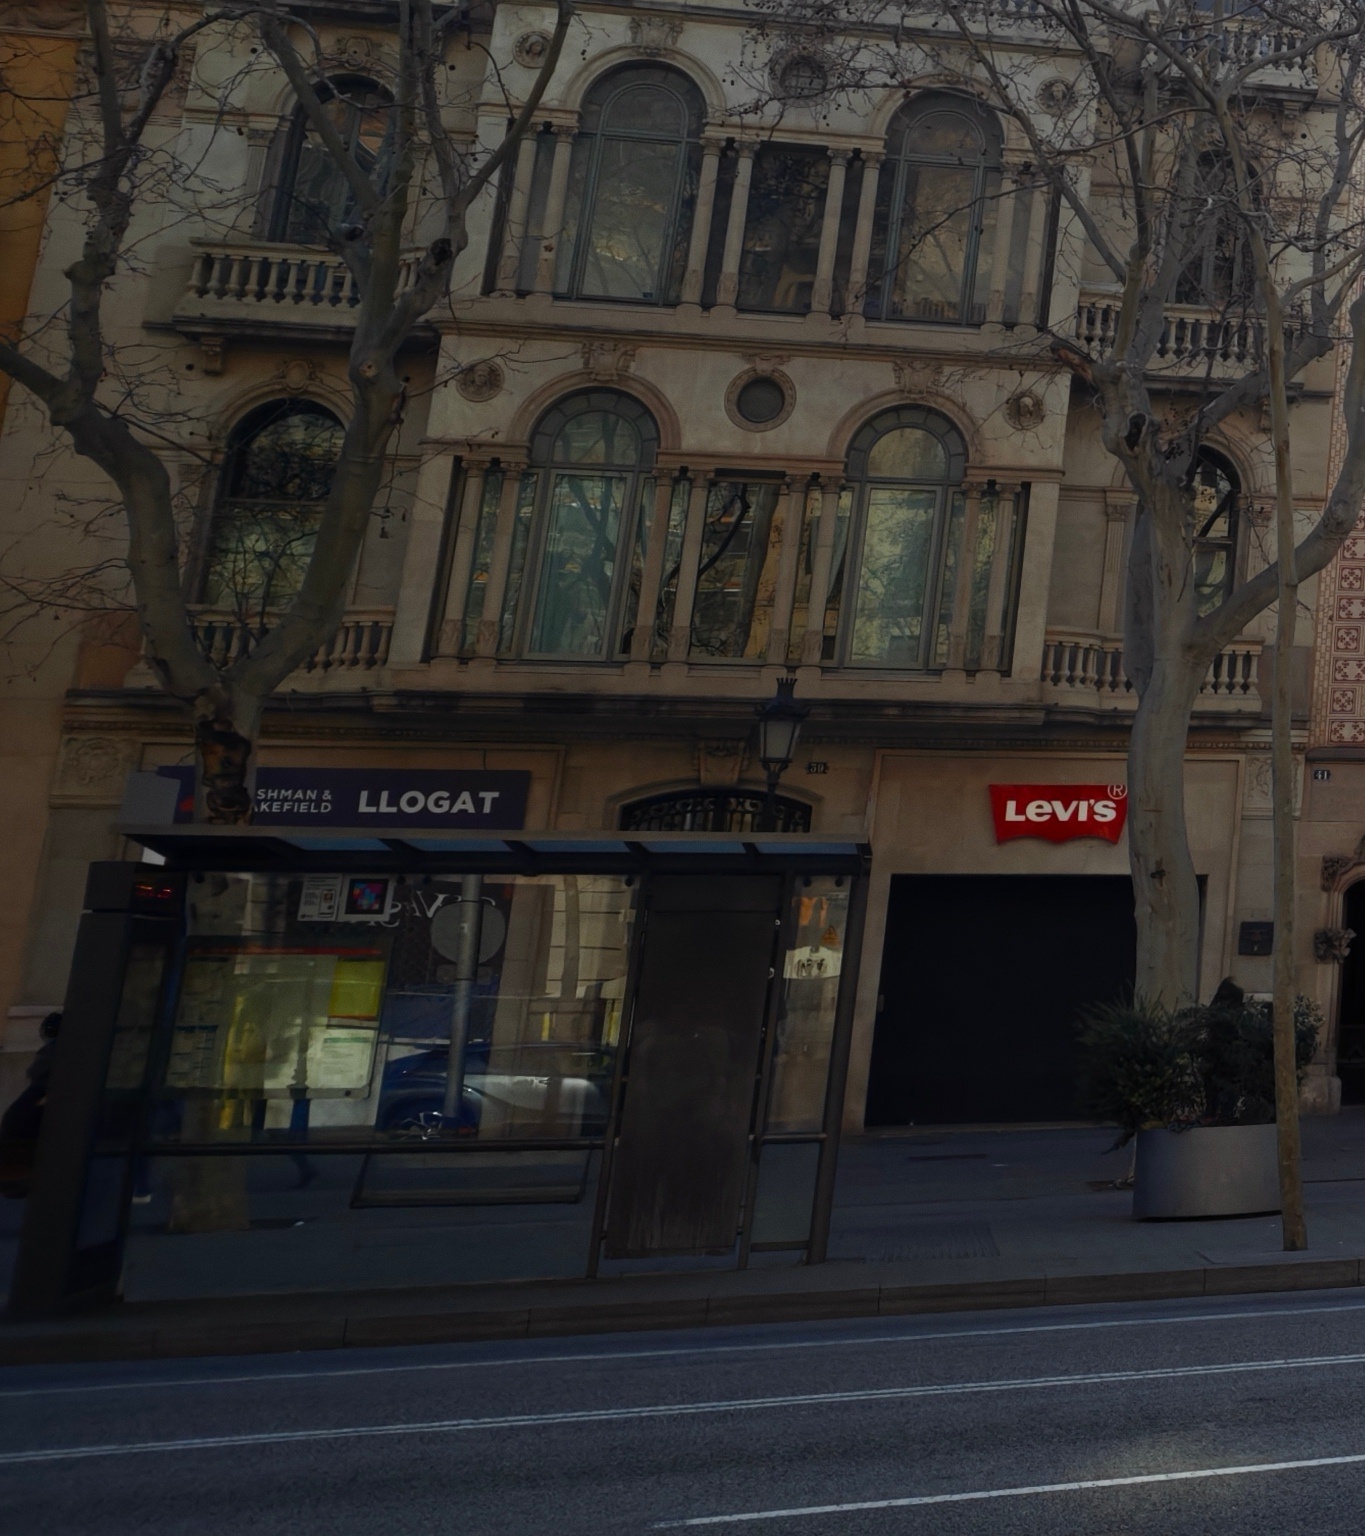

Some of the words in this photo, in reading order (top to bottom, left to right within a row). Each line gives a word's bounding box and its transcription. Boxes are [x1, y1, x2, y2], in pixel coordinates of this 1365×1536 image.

[256, 788, 317, 800] SHMAN
[322, 789, 332, 800] &
[358, 790, 500, 814] LLOGAT
